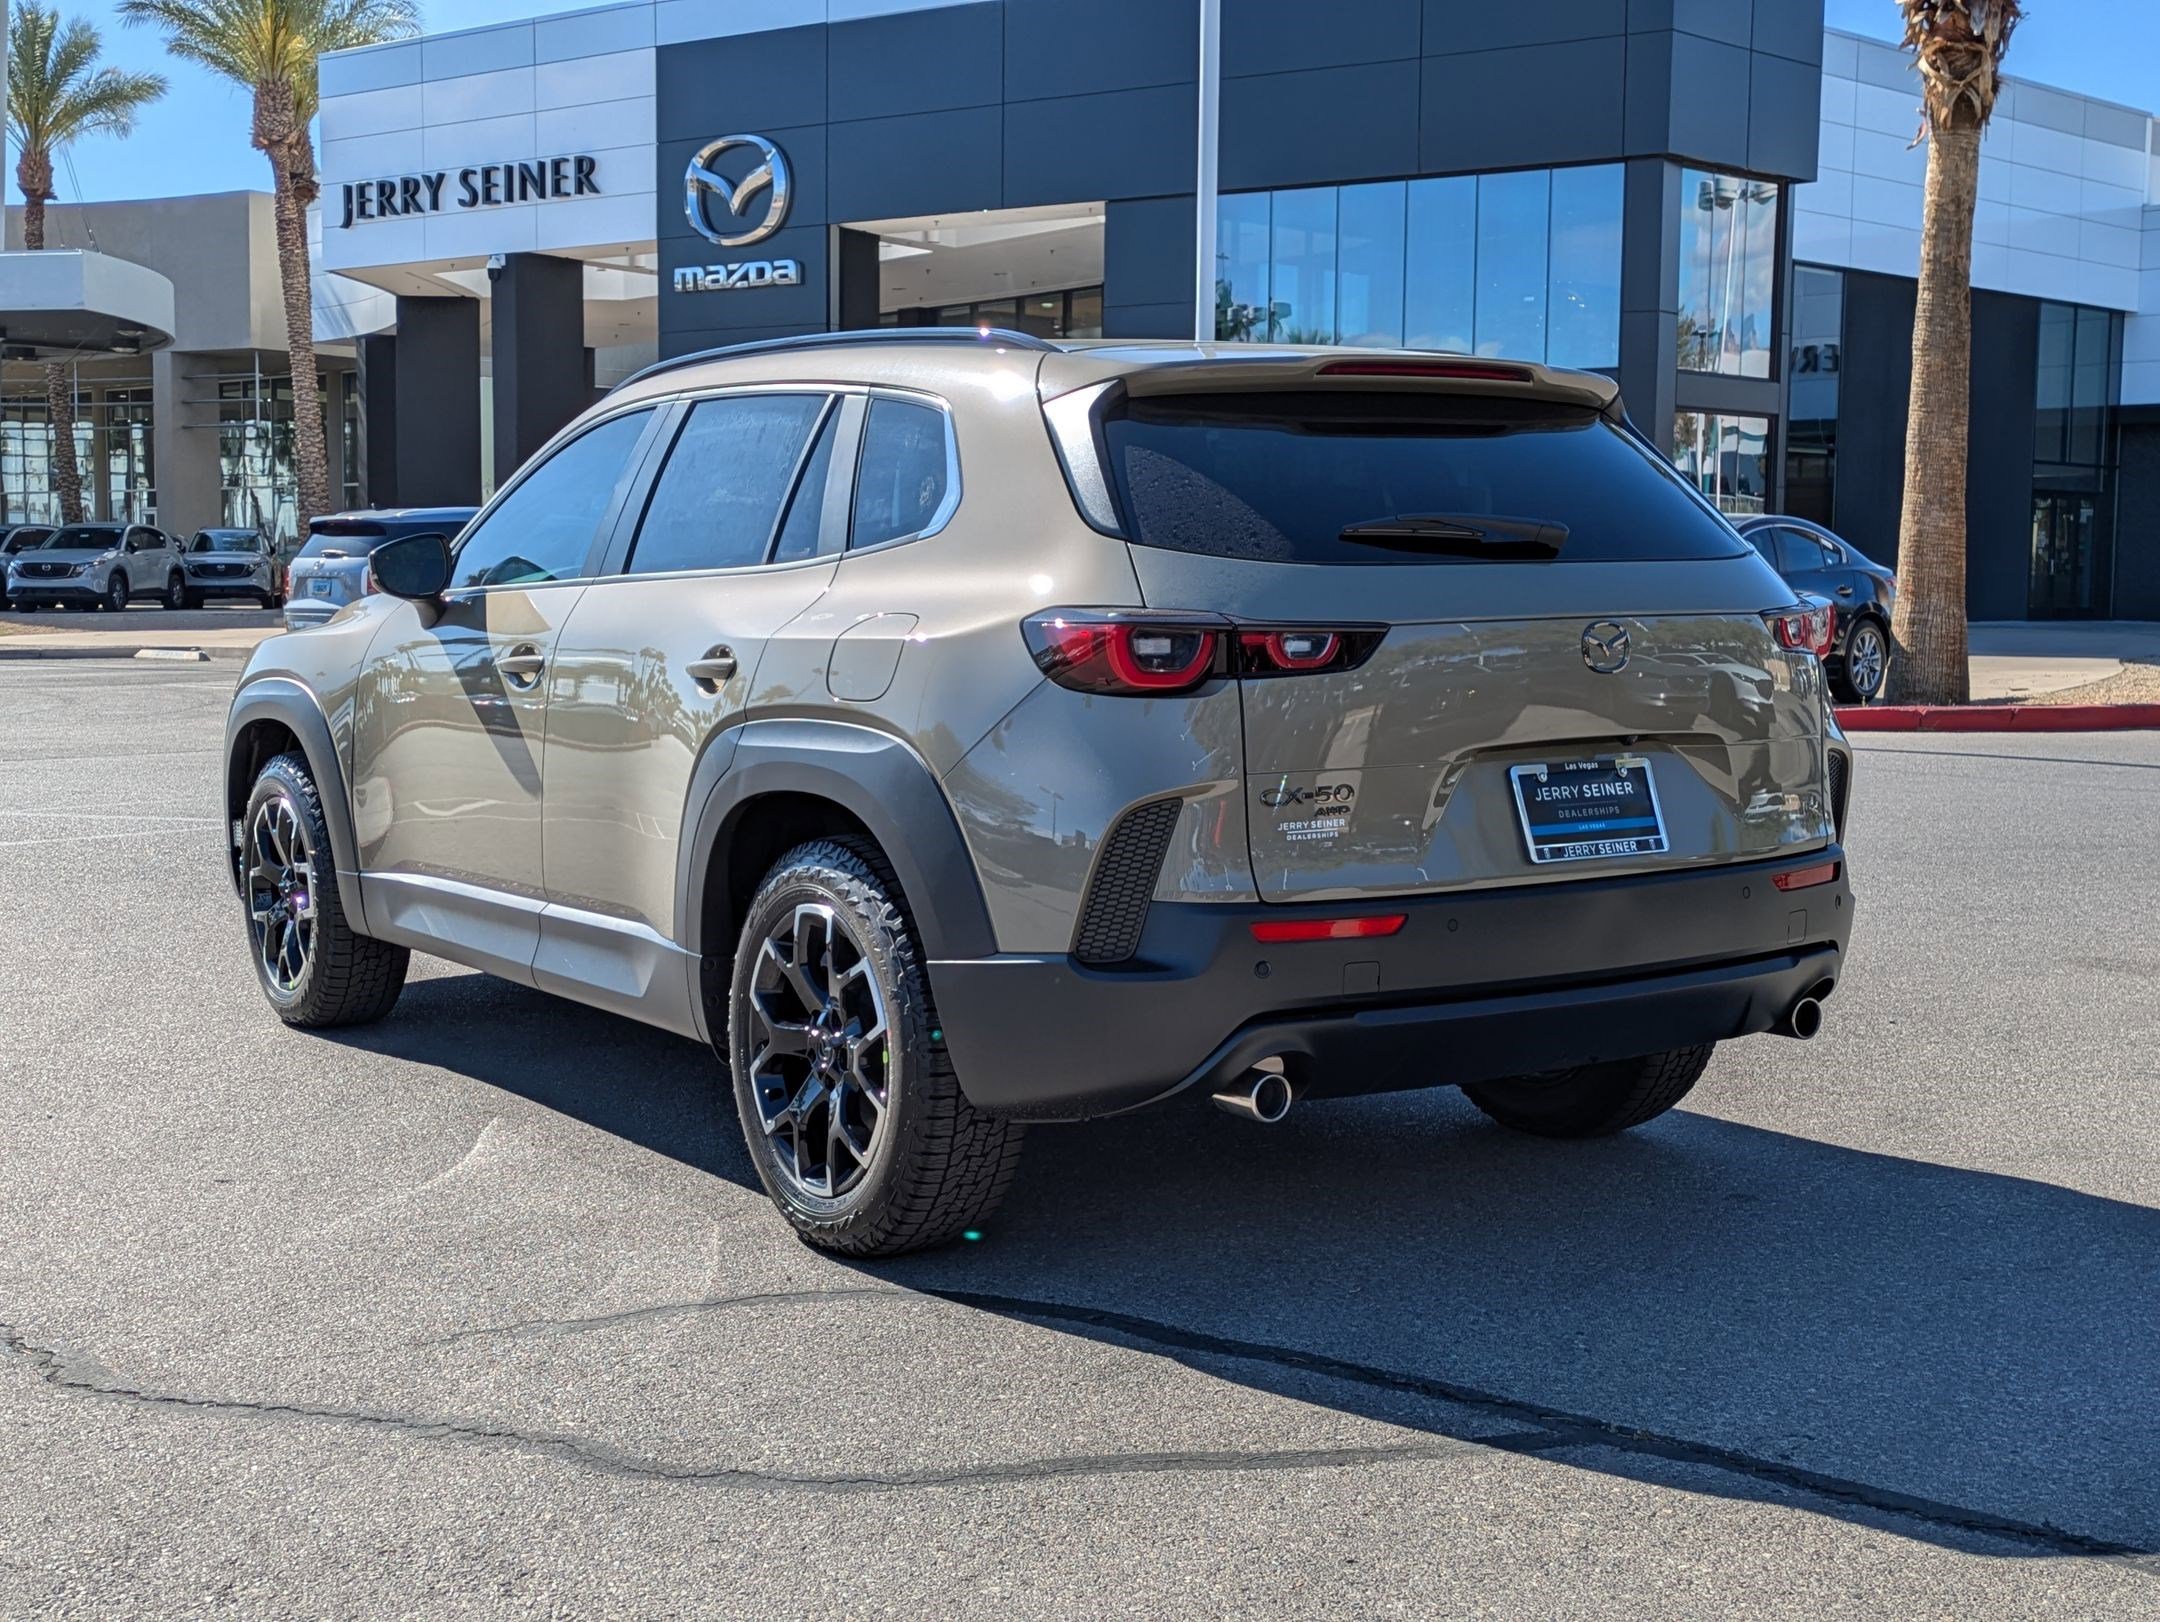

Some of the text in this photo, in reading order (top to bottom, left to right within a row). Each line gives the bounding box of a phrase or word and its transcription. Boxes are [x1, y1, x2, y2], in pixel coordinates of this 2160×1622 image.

[339, 155, 600, 229] JERRY SEINER
[1564, 761, 1599, 771] Las Vegas
[1260, 783, 1355, 808] CX-50
[1535, 781, 1634, 801] JERRY SEINER
[1558, 805, 1620, 819] DEALERSHIPS
[1277, 818, 1345, 832] JERRY SEINER
[1286, 831, 1339, 841] DEALERSHIPS
[1563, 840, 1638, 858] JERRY SEINER
